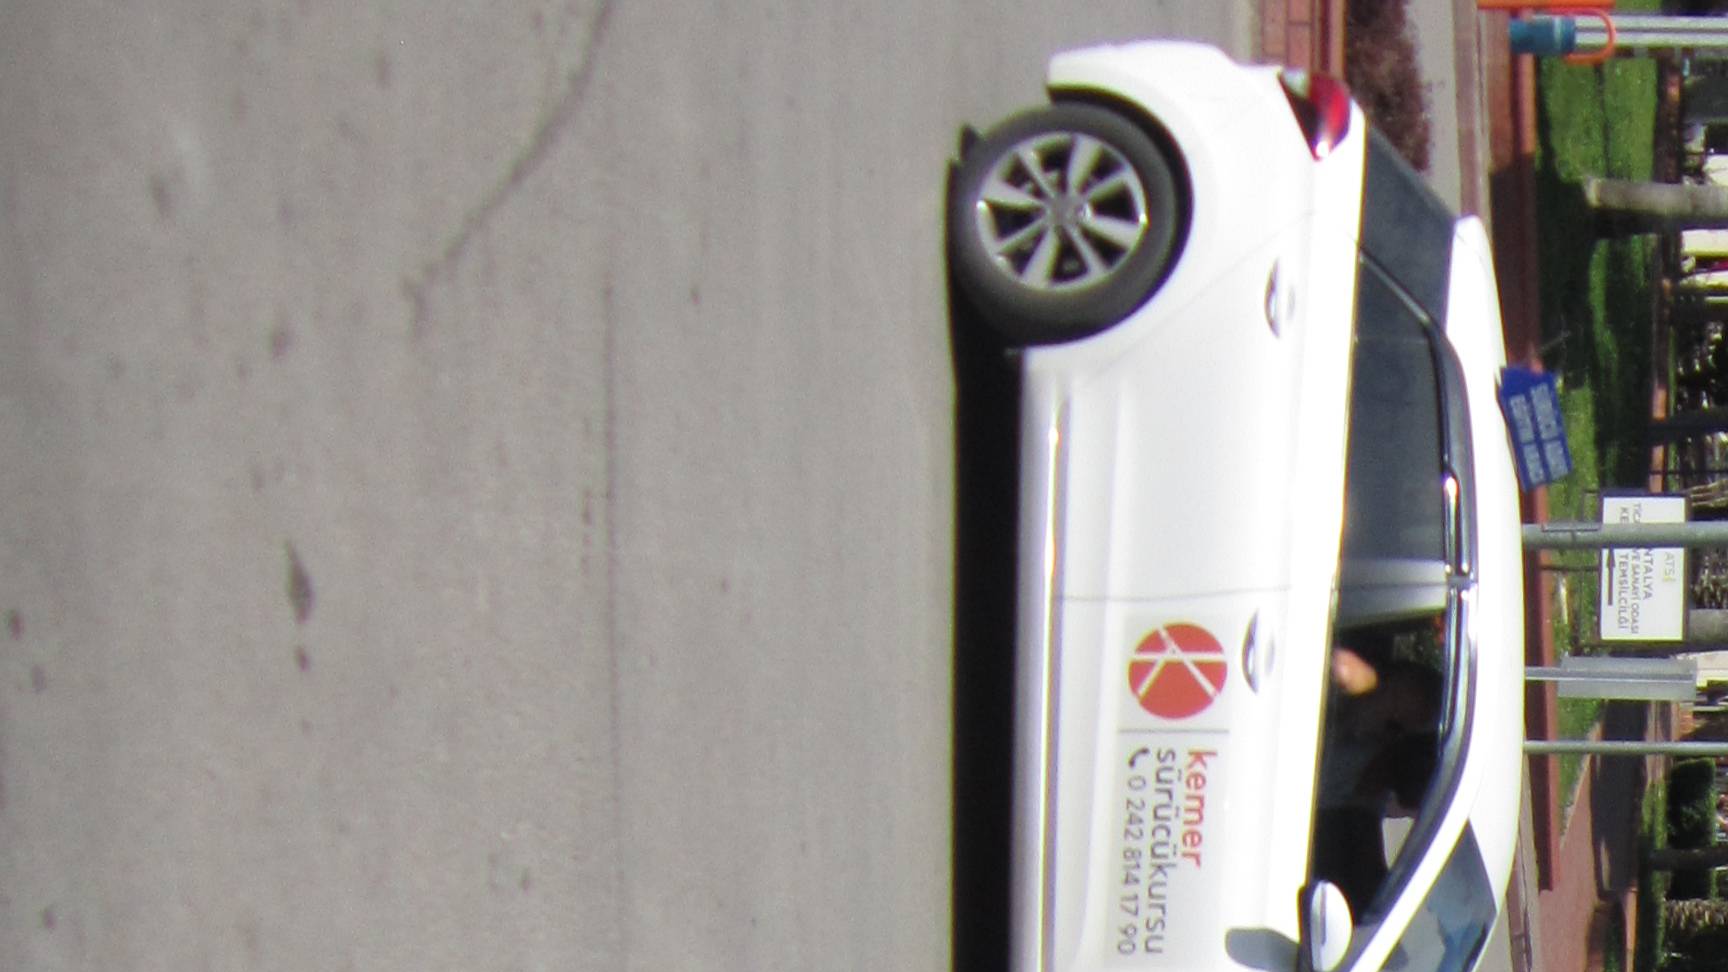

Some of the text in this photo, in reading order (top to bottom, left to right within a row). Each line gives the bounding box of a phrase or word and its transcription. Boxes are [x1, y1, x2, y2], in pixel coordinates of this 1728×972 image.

[1631, 548, 1641, 561] VE
[1643, 548, 1654, 600] NTALYA
[1630, 564, 1641, 600] SANAYİ
[1630, 603, 1640, 634] ODASI
[1182, 750, 1218, 868] kemer
[1117, 775, 1147, 955] 0 242 814 17 90
[1144, 749, 1183, 954] sürücükursu
